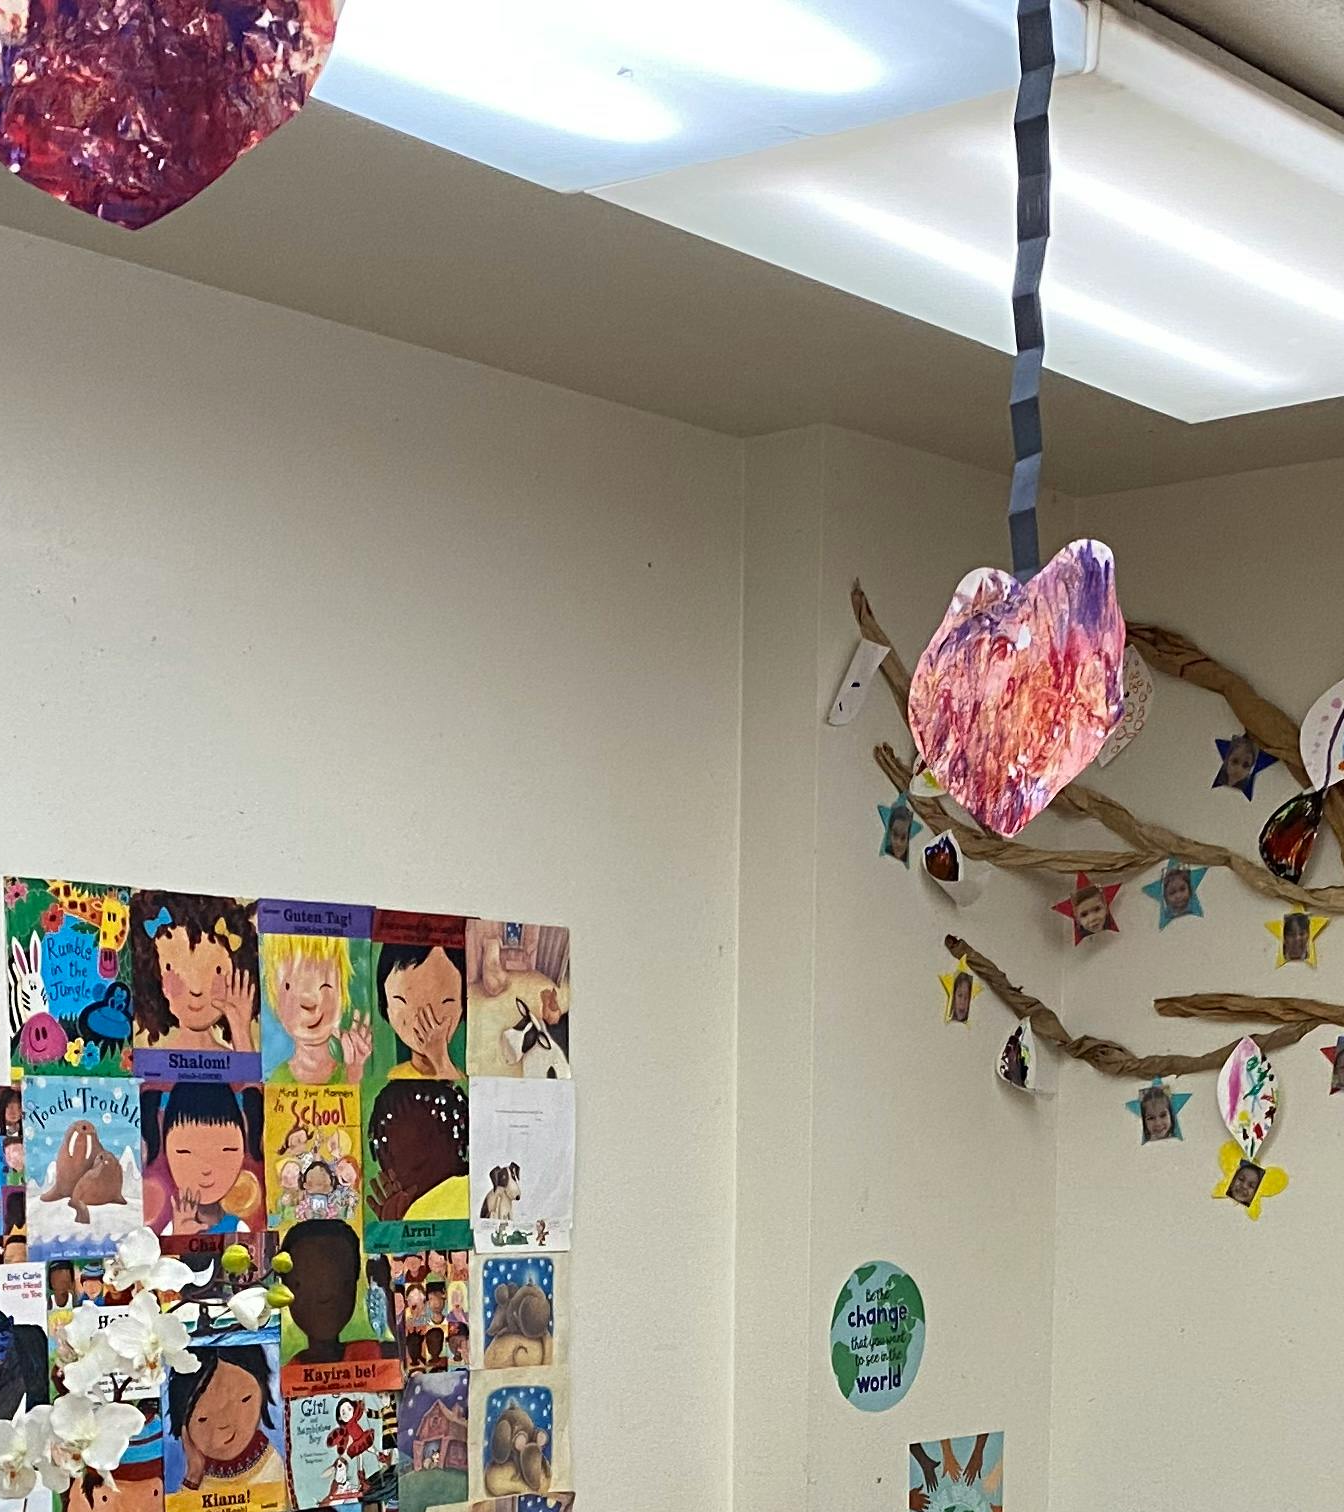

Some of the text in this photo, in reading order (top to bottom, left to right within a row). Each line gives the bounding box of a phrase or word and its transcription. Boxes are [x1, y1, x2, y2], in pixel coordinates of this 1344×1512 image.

[283, 908, 352, 927] Guten Tag!
[47, 937, 92, 960] Rumble
[51, 961, 88, 977] in the
[50, 980, 90, 1002] Jungle
[168, 1053, 231, 1070] Shalom!
[29, 1090, 74, 1129] Tooth
[847, 1304, 907, 1331] change
[851, 1335, 869, 1351] that
[303, 1364, 376, 1384] Kayira be!
[856, 1364, 902, 1394] world
[202, 1488, 251, 1508] Kiana!
